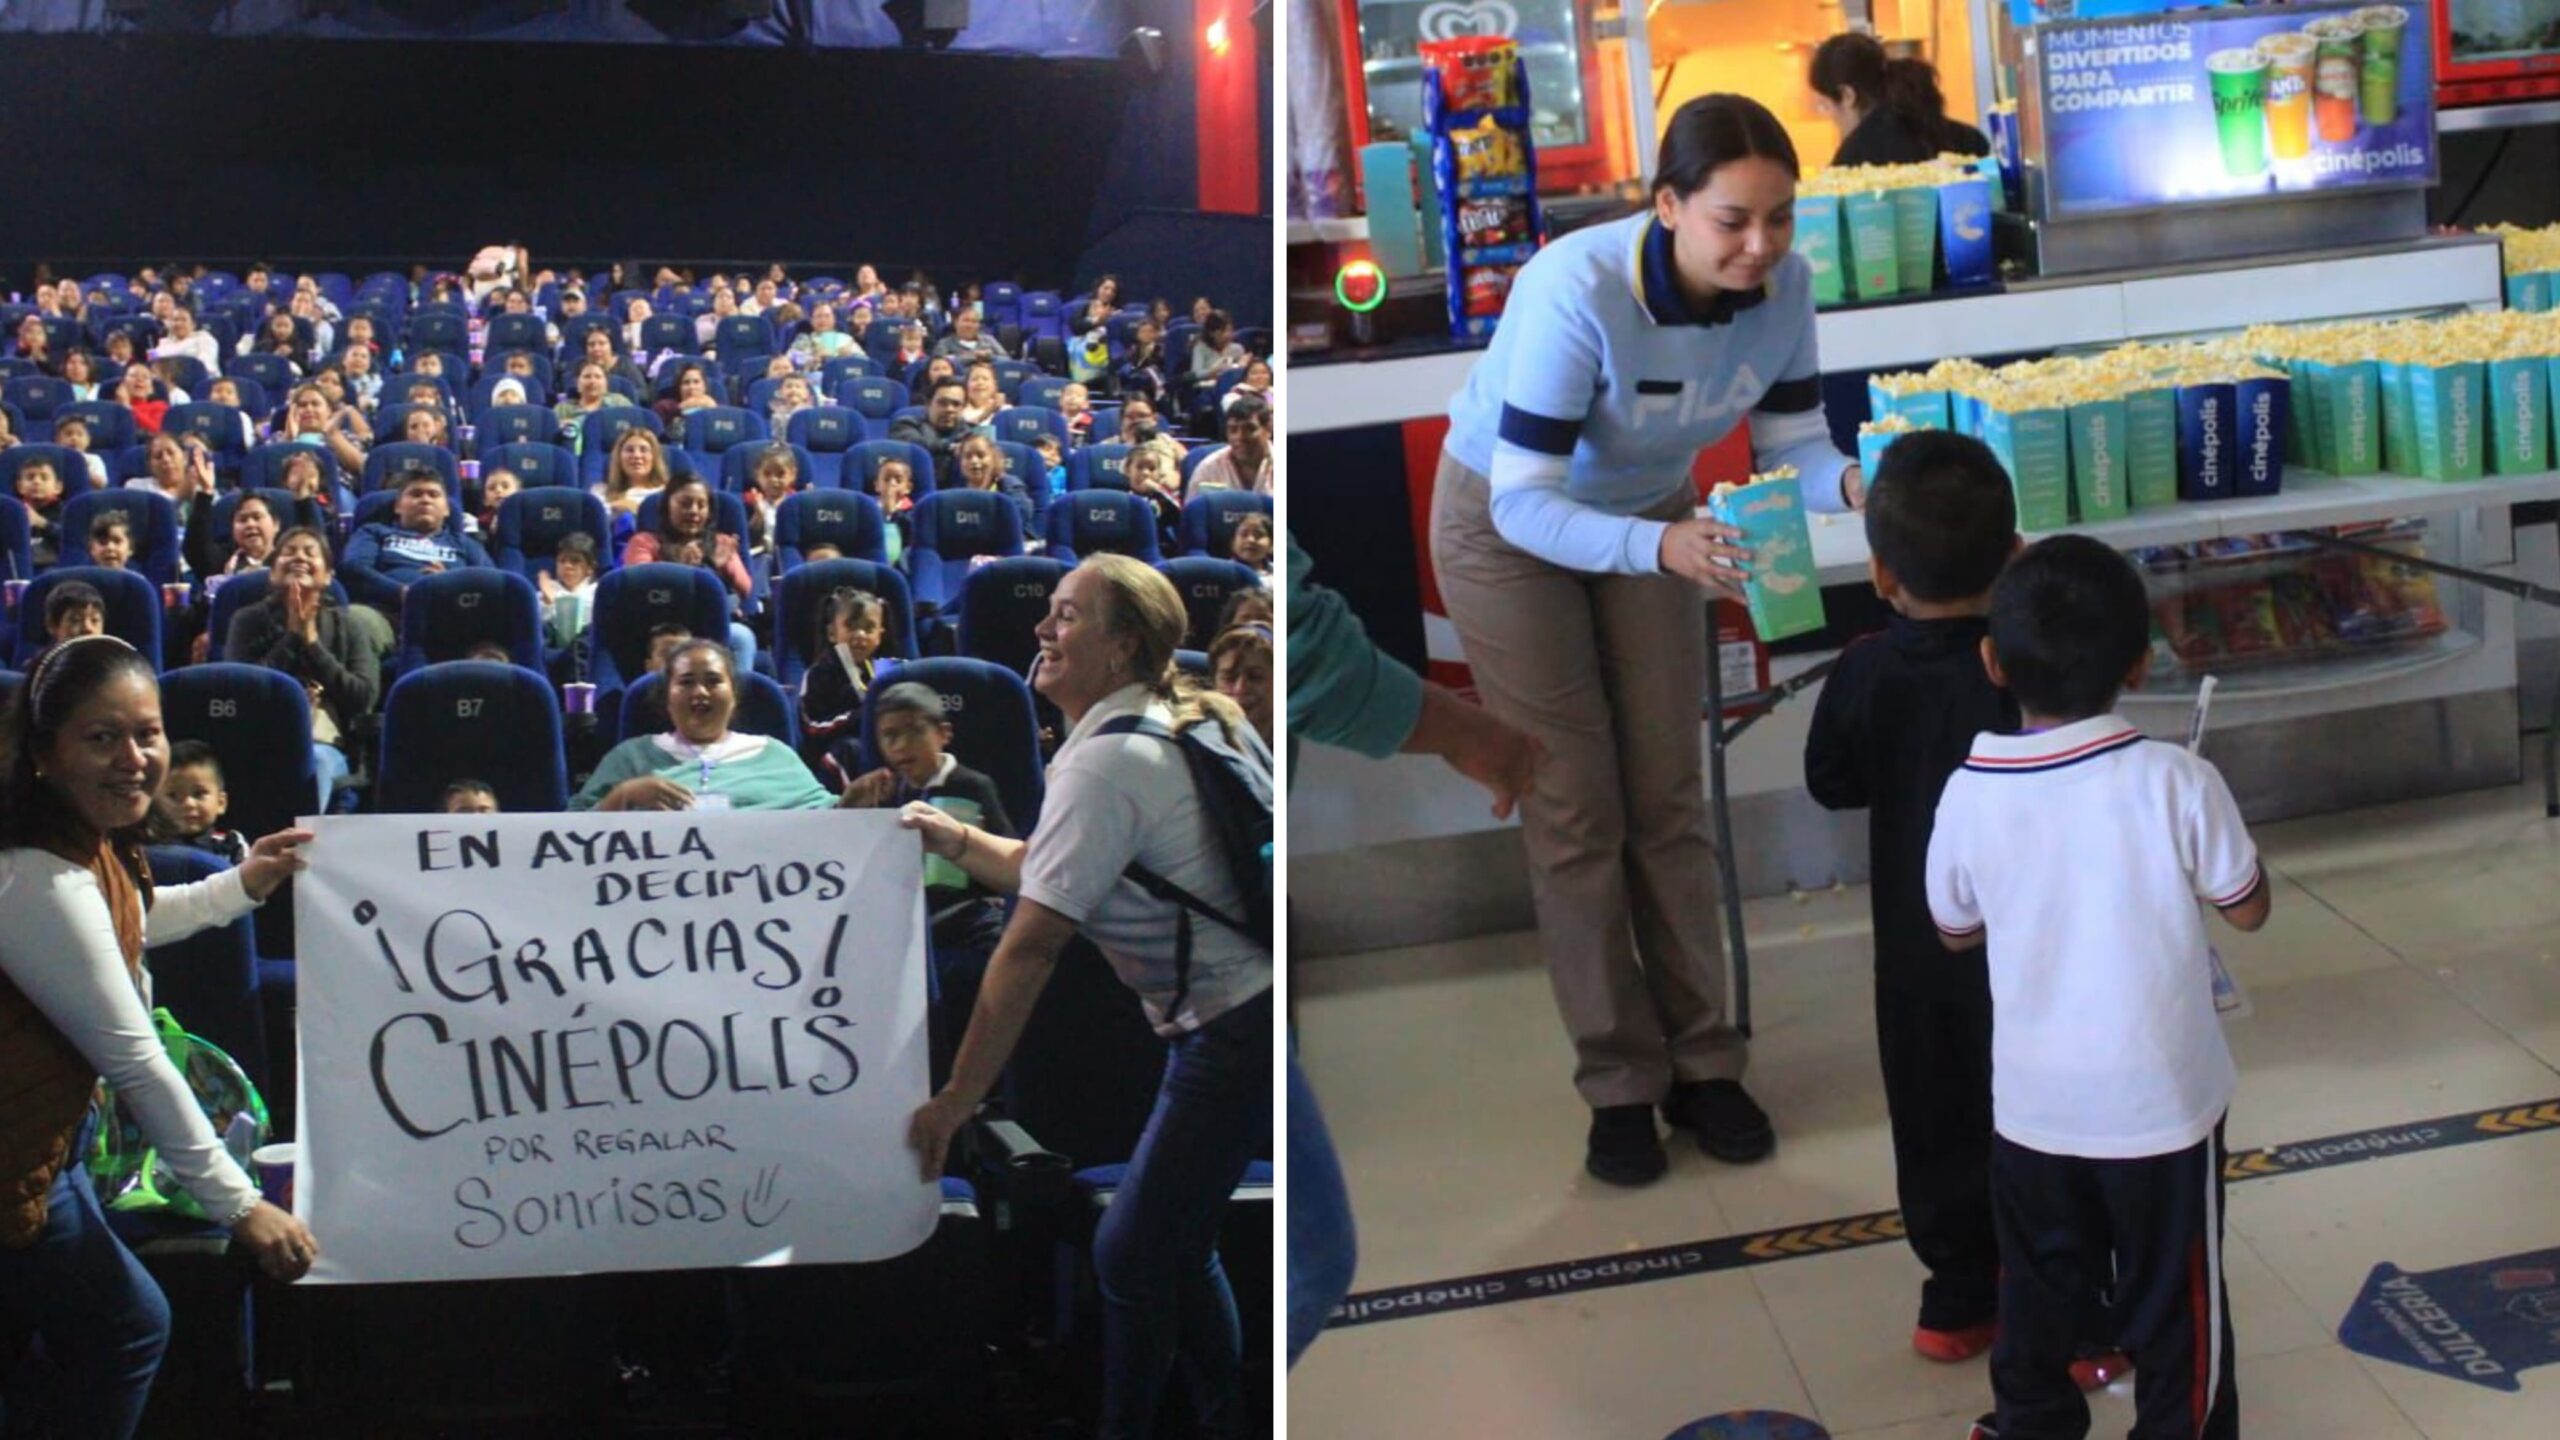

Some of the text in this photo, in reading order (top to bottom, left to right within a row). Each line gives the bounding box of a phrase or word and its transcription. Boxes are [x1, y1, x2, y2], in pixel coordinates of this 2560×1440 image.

[2049, 42, 2193, 70] DIVERTIDOS
[2050, 69, 2115, 91] PARA
[2051, 83, 2195, 113] COMPARTIR
[2315, 143, 2425, 173] cinépolis
[1631, 362, 1764, 431] FILA
[2199, 397, 2217, 487] cinépolis
[2250, 392, 2270, 482] cinépolis
[458, 593, 481, 608] C7
[1014, 583, 1045, 599] C10
[1192, 583, 1220, 599] C11
[208, 700, 237, 718] B6
[456, 699, 484, 718] B7
[416, 826, 716, 872] EN AYALA
[594, 860, 847, 907] DECIMOS
[369, 1002, 861, 1141] CINÉPOLIS
[484, 1124, 738, 1167] POR REGALAR
[2279, 1127, 2443, 1166] cinépolis
[453, 1174, 729, 1250] Sonrisas
[1523, 1250, 1704, 1290] cinépolis
